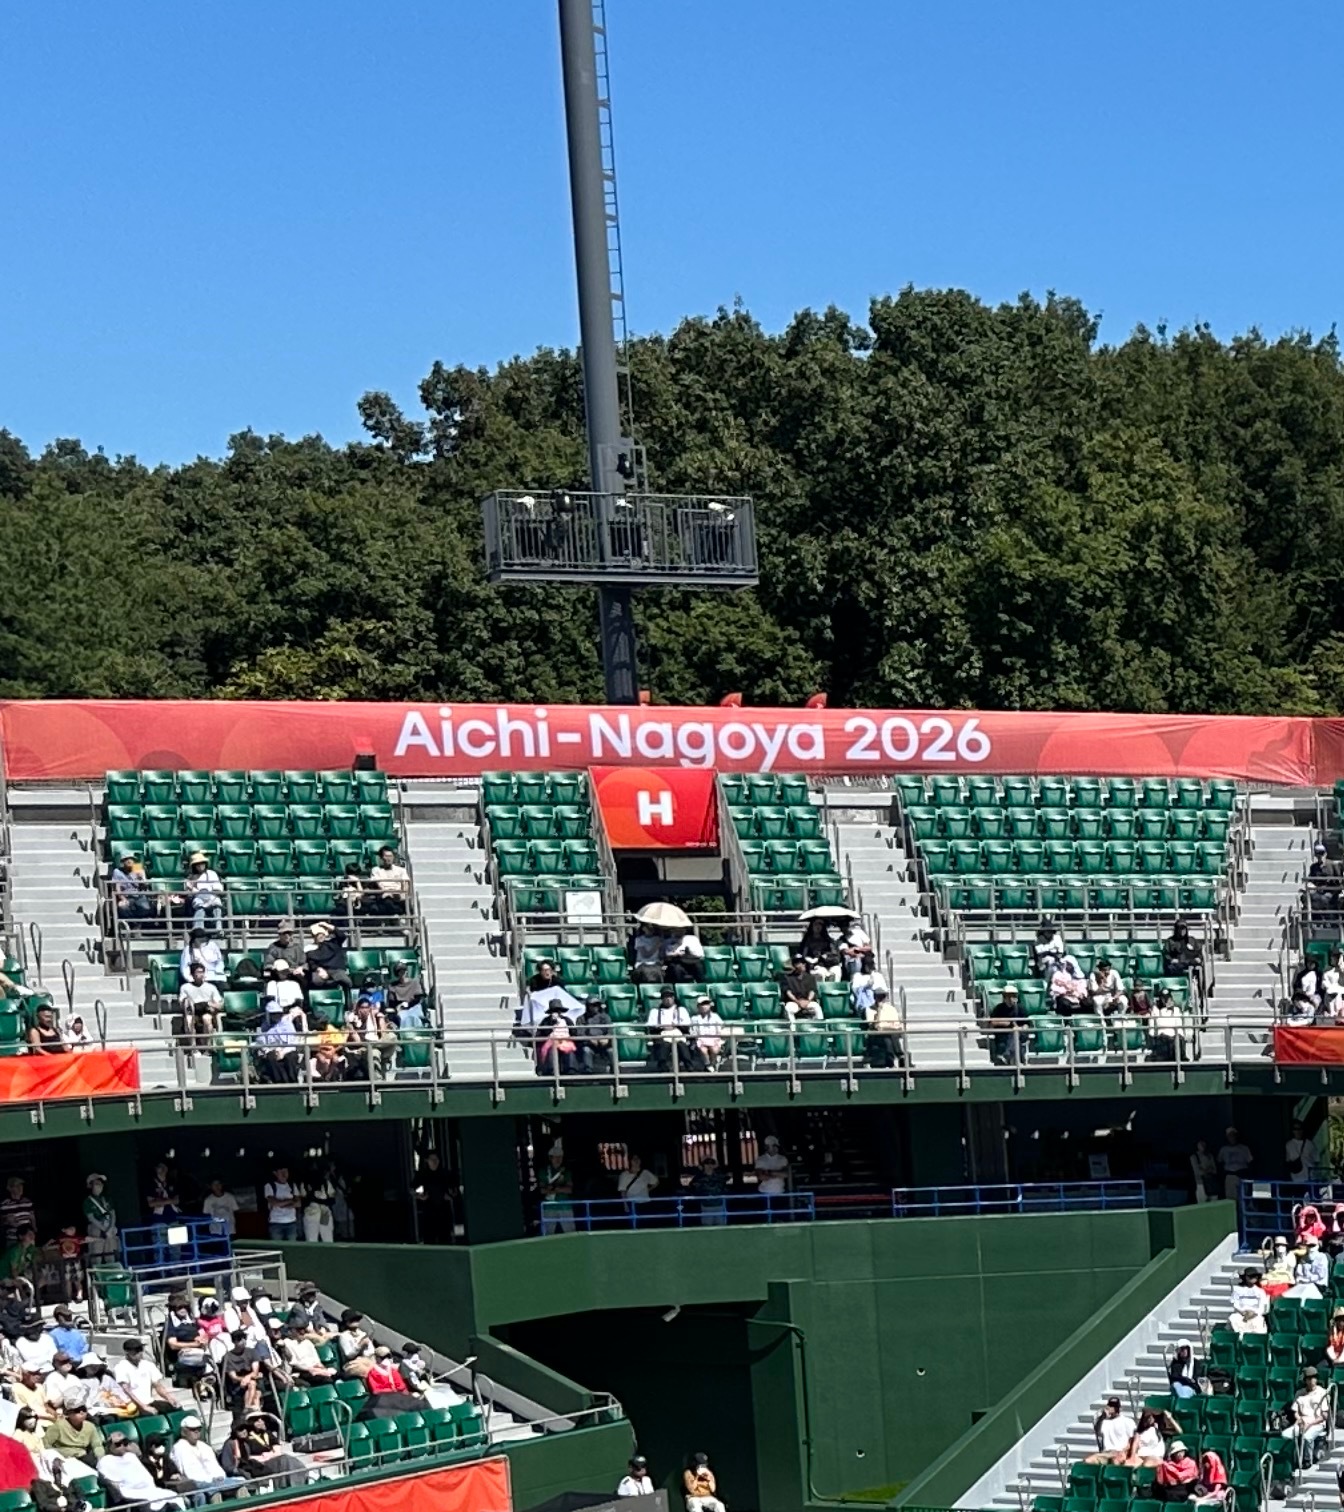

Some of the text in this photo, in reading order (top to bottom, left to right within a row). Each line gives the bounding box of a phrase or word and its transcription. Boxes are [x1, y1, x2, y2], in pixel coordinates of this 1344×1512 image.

[394, 707, 992, 773] Aichi-Nagoya 2026
[637, 790, 674, 826] H
